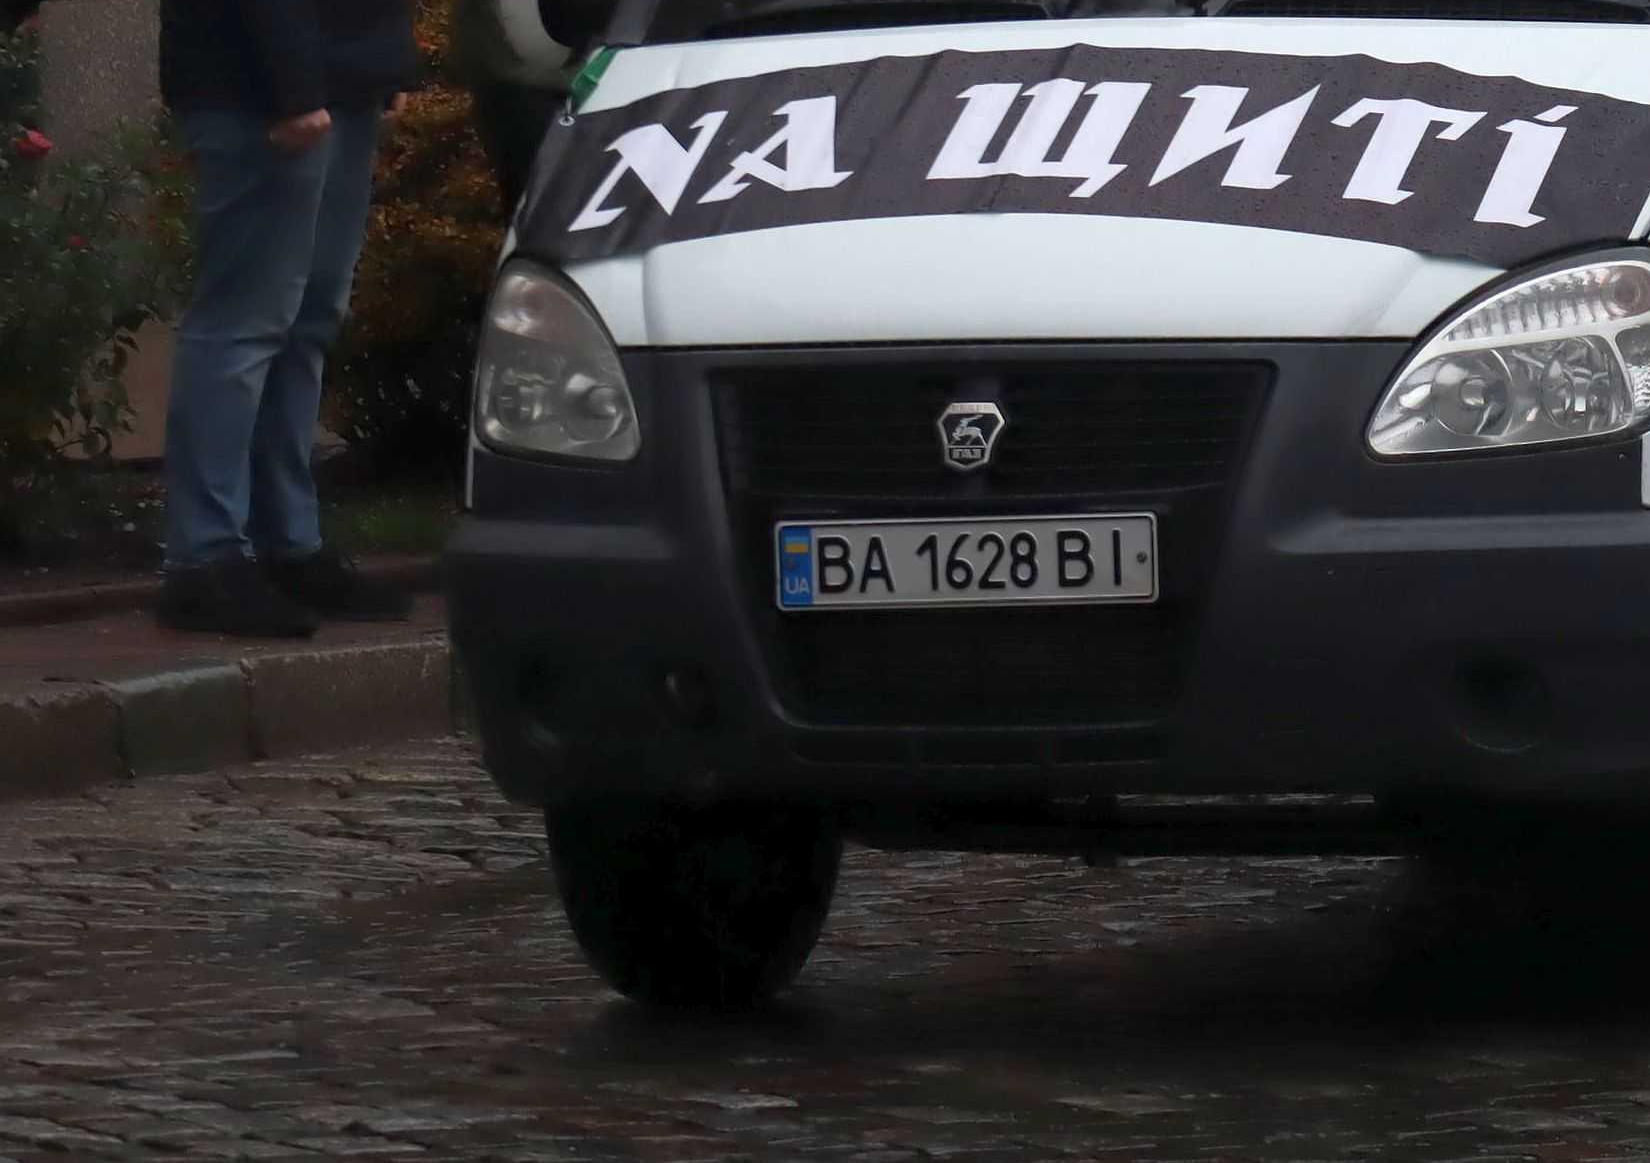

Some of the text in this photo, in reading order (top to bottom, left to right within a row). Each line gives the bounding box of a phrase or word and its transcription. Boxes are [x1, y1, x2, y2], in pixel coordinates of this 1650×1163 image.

[816, 534, 896, 595] BA
[914, 530, 1040, 591] 1628
[784, 576, 812, 596] UA
